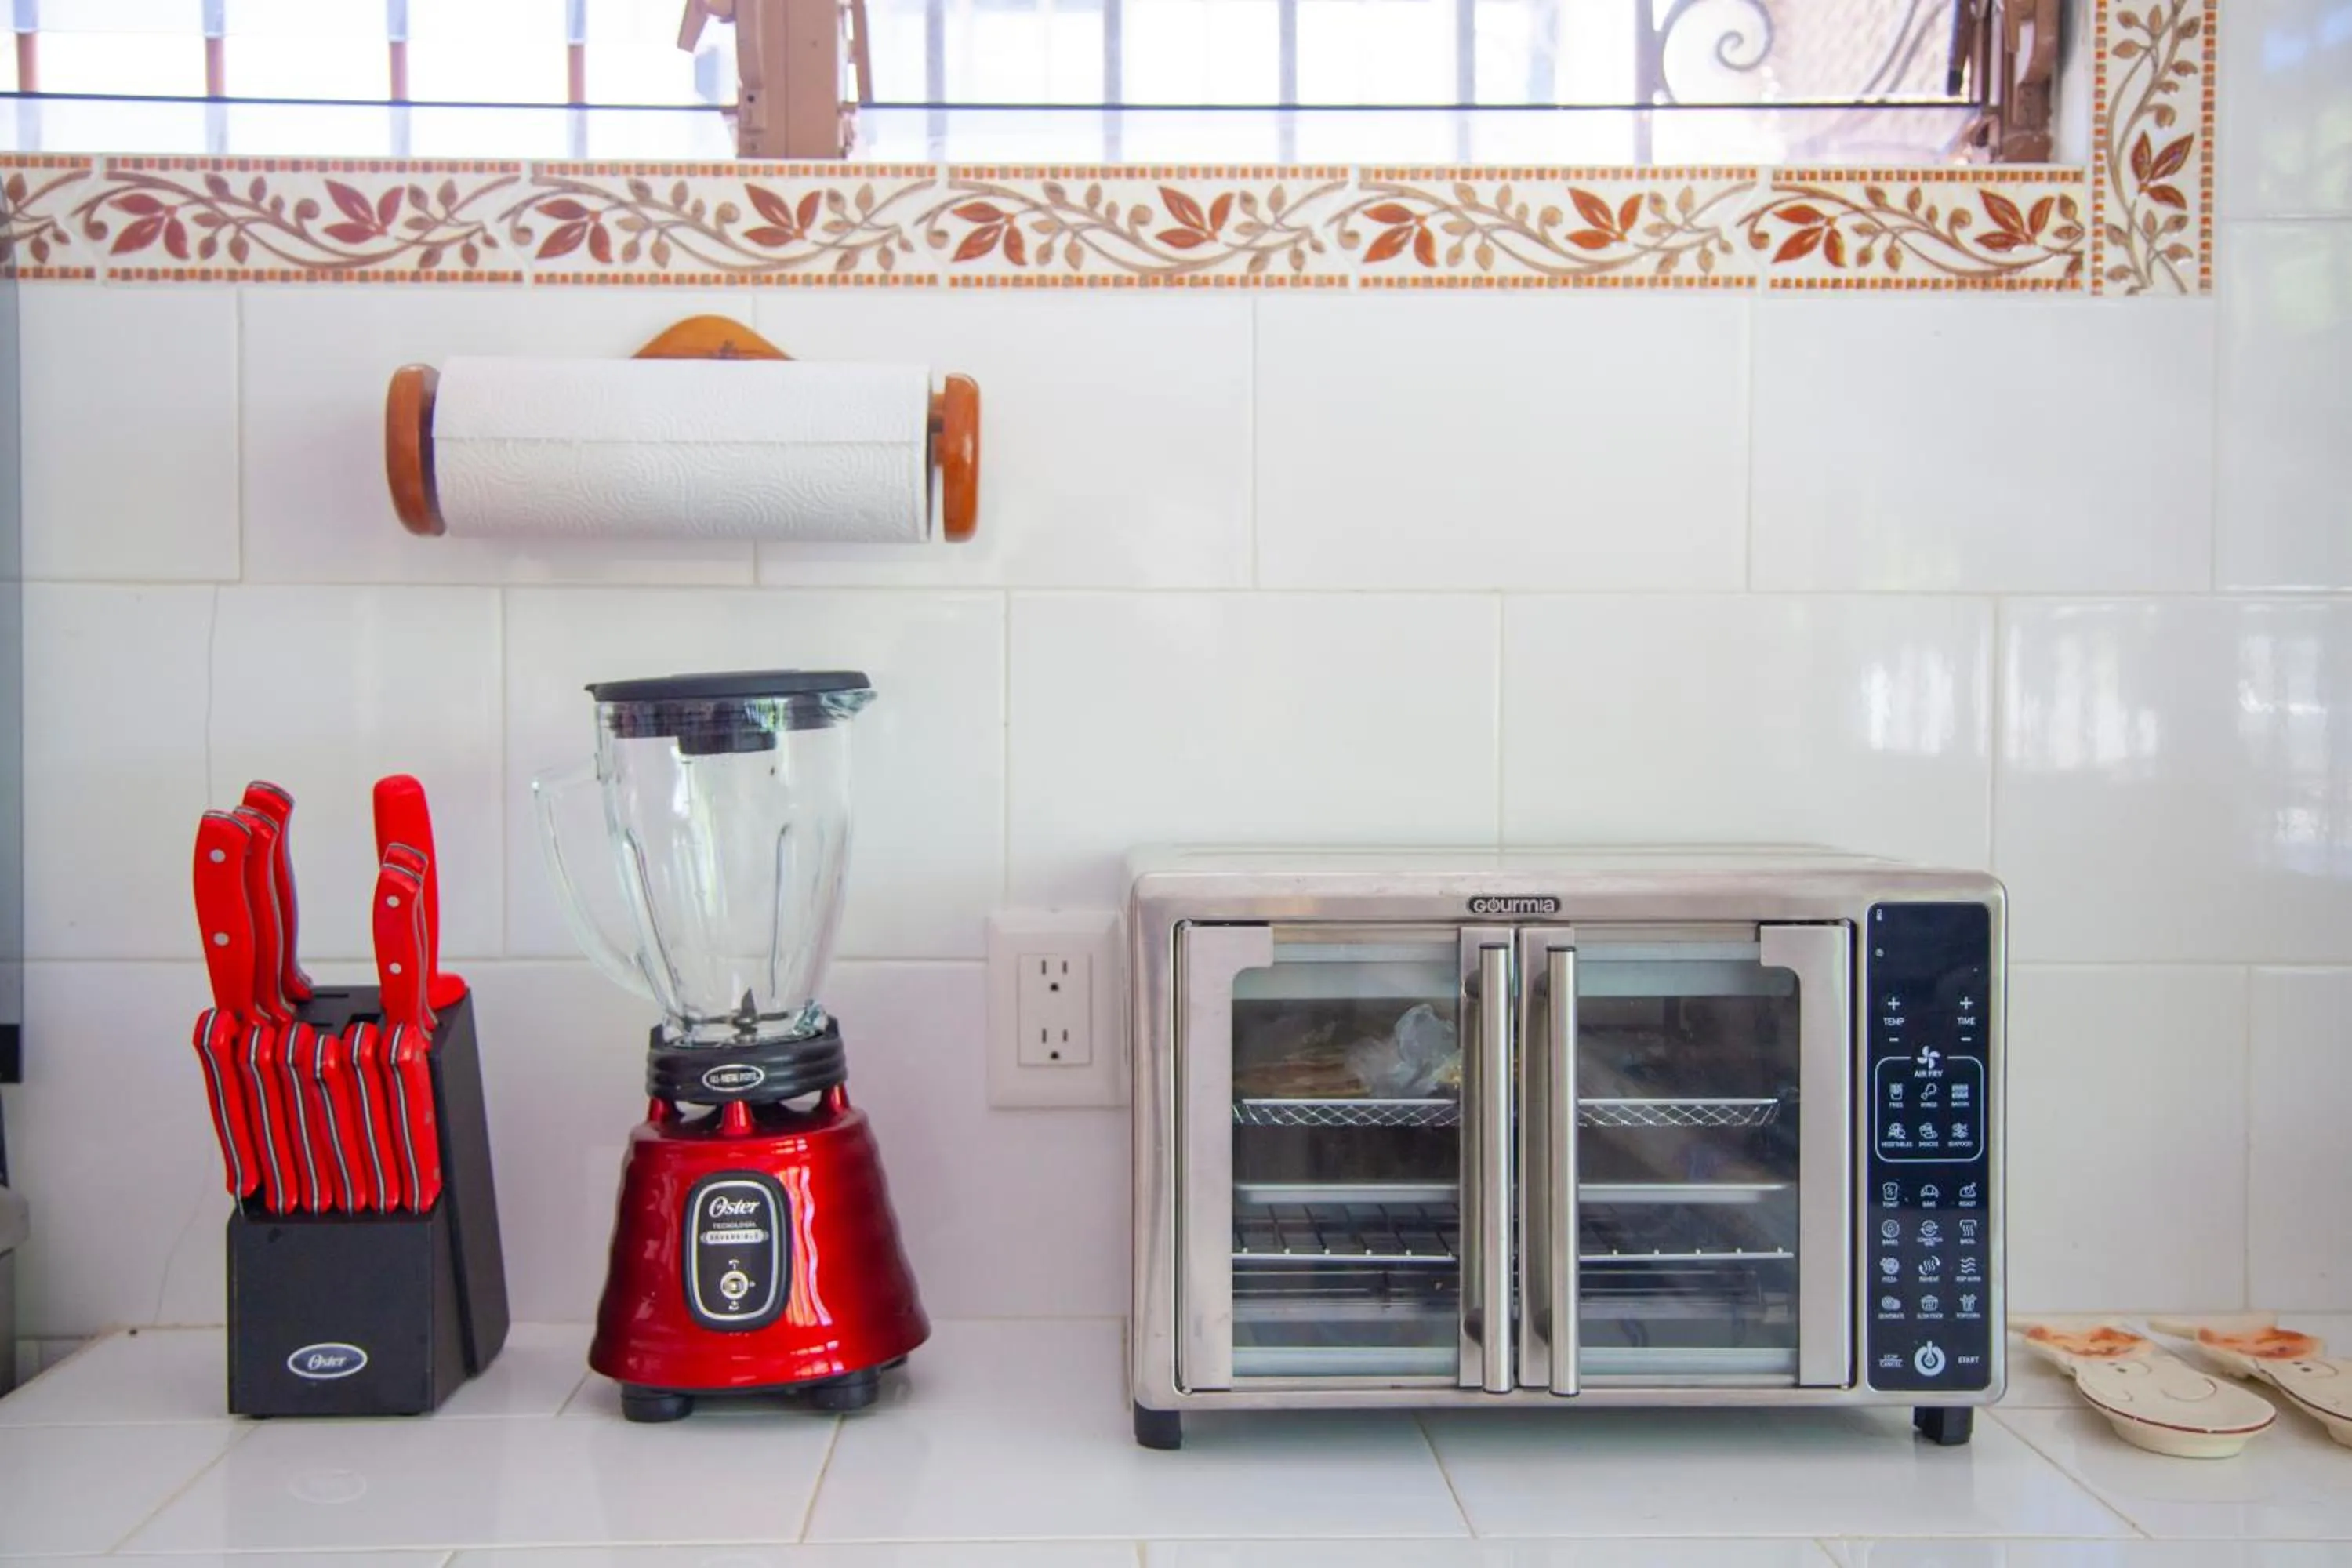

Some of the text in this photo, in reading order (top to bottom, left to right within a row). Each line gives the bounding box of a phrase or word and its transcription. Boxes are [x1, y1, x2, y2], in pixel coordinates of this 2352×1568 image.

[1883, 1017, 1904, 1026] TEMP
[1957, 1016, 1976, 1025] TIME
[1914, 1069, 1944, 1078] AIR FRY
[708, 1196, 760, 1218] Oster
[307, 1354, 347, 1370] Oster
[1958, 1356, 1980, 1364] START
